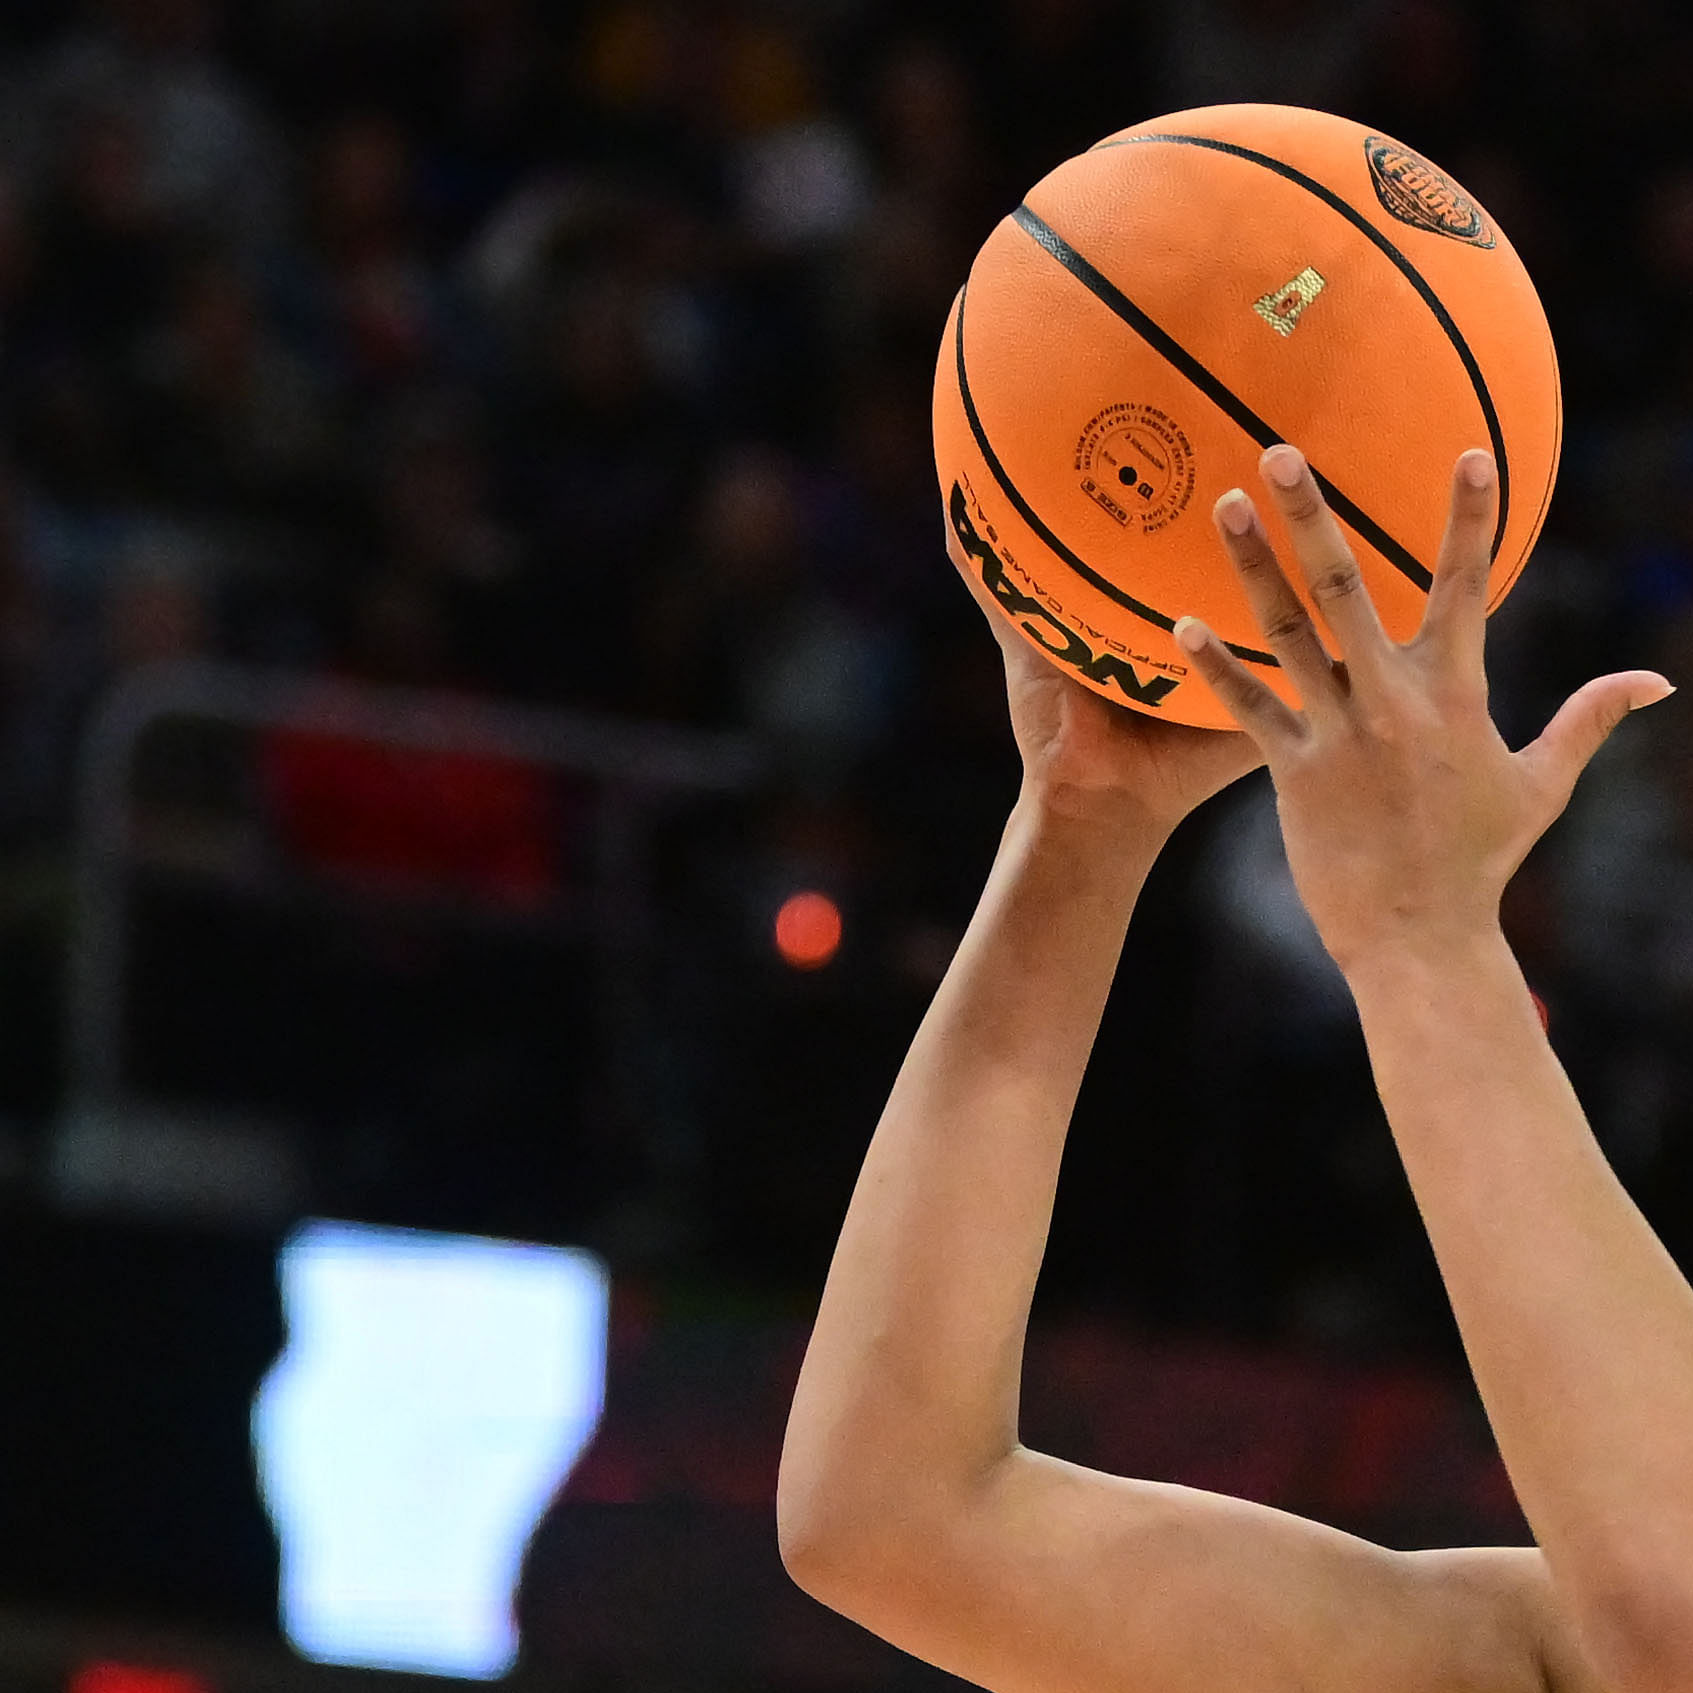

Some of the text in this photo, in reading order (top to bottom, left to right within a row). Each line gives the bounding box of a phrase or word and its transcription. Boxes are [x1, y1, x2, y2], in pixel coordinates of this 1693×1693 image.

[950, 480, 1180, 707] NCAA
[962, 471, 1188, 677] OFFICIAL GAME BALL
